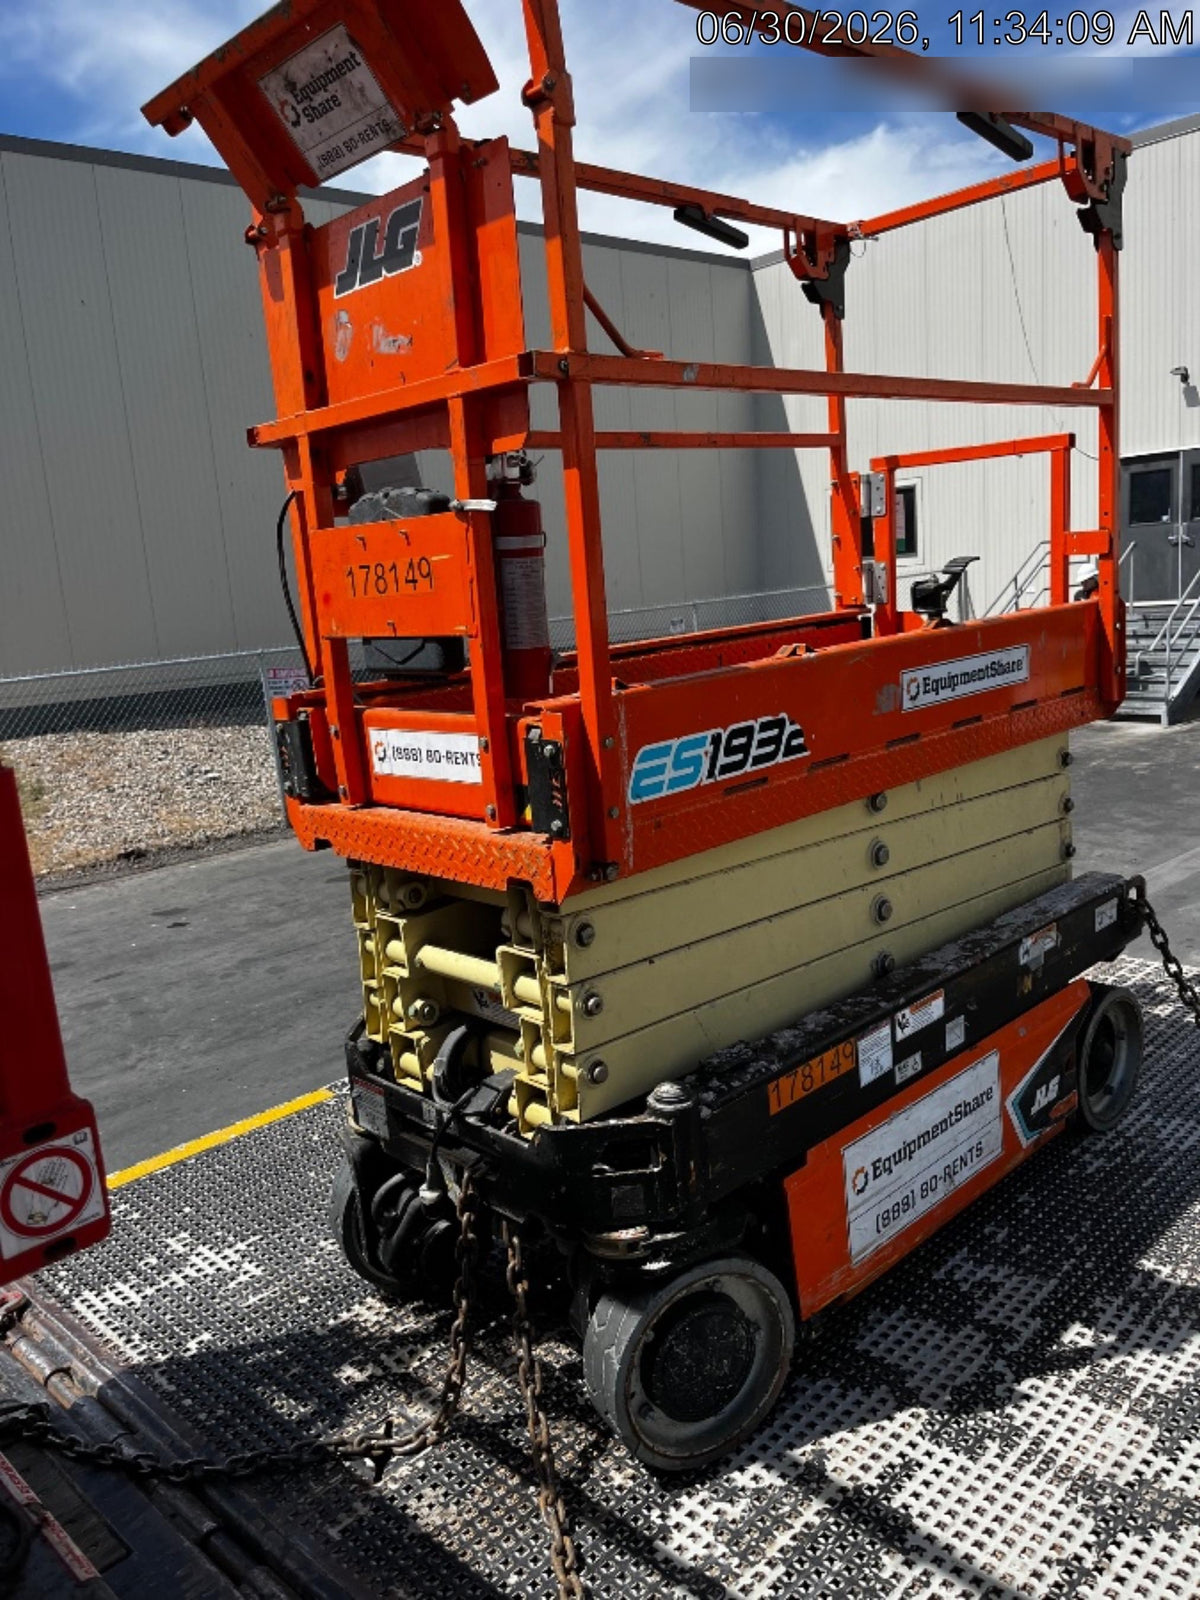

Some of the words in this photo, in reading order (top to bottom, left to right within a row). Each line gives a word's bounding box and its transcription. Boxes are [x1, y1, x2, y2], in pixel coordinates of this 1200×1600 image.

[290, 51, 362, 106] Equipment
[302, 94, 342, 124] Share
[334, 196, 423, 299] JLG
[346, 556, 433, 597] 178149
[922, 658, 1024, 696] EquipmentShare
[771, 1040, 855, 1109] 178149
[871, 1085, 994, 1182] EquipmentShare
[920, 1140, 984, 1199] 80-RENTS
